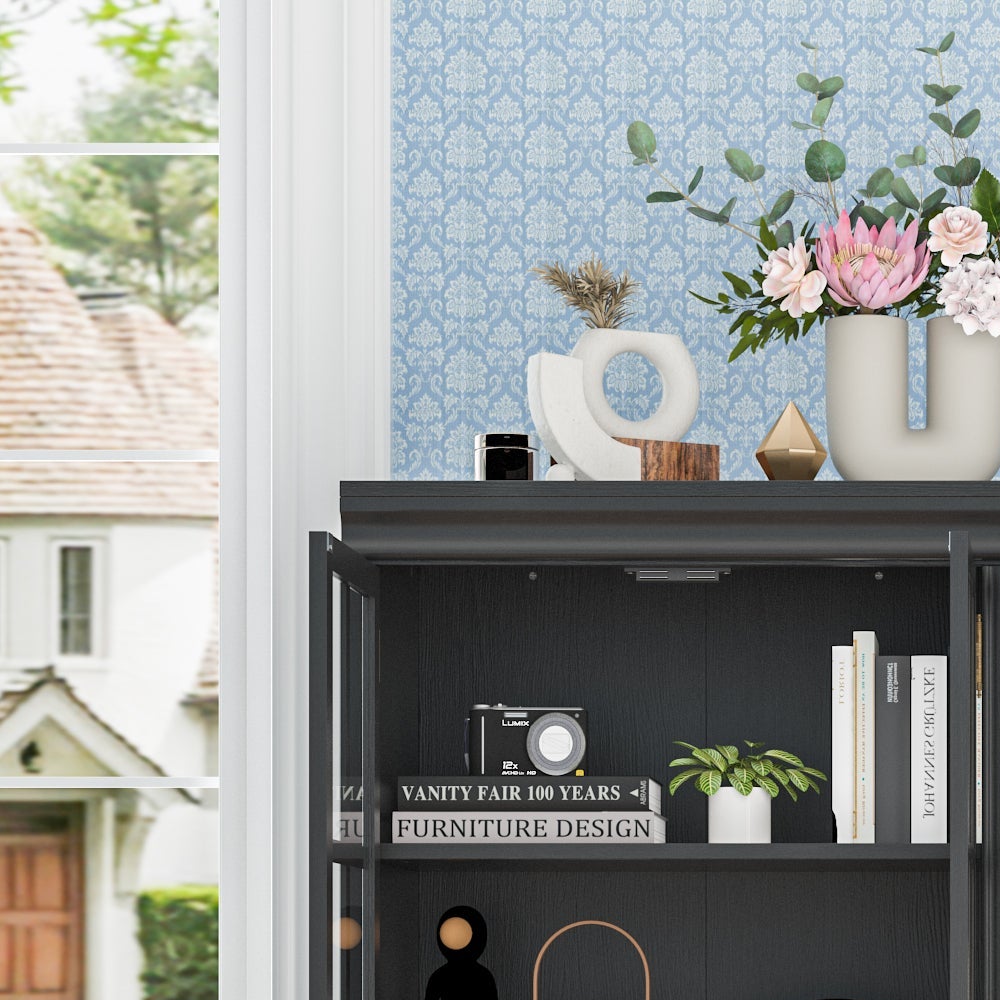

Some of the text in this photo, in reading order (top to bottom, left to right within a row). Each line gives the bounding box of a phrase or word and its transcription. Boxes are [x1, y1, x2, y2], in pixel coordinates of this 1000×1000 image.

[402, 785, 620, 800] VANITY FAIR 100 YEARS
[398, 818, 650, 838] FURNITURE DESIGN
